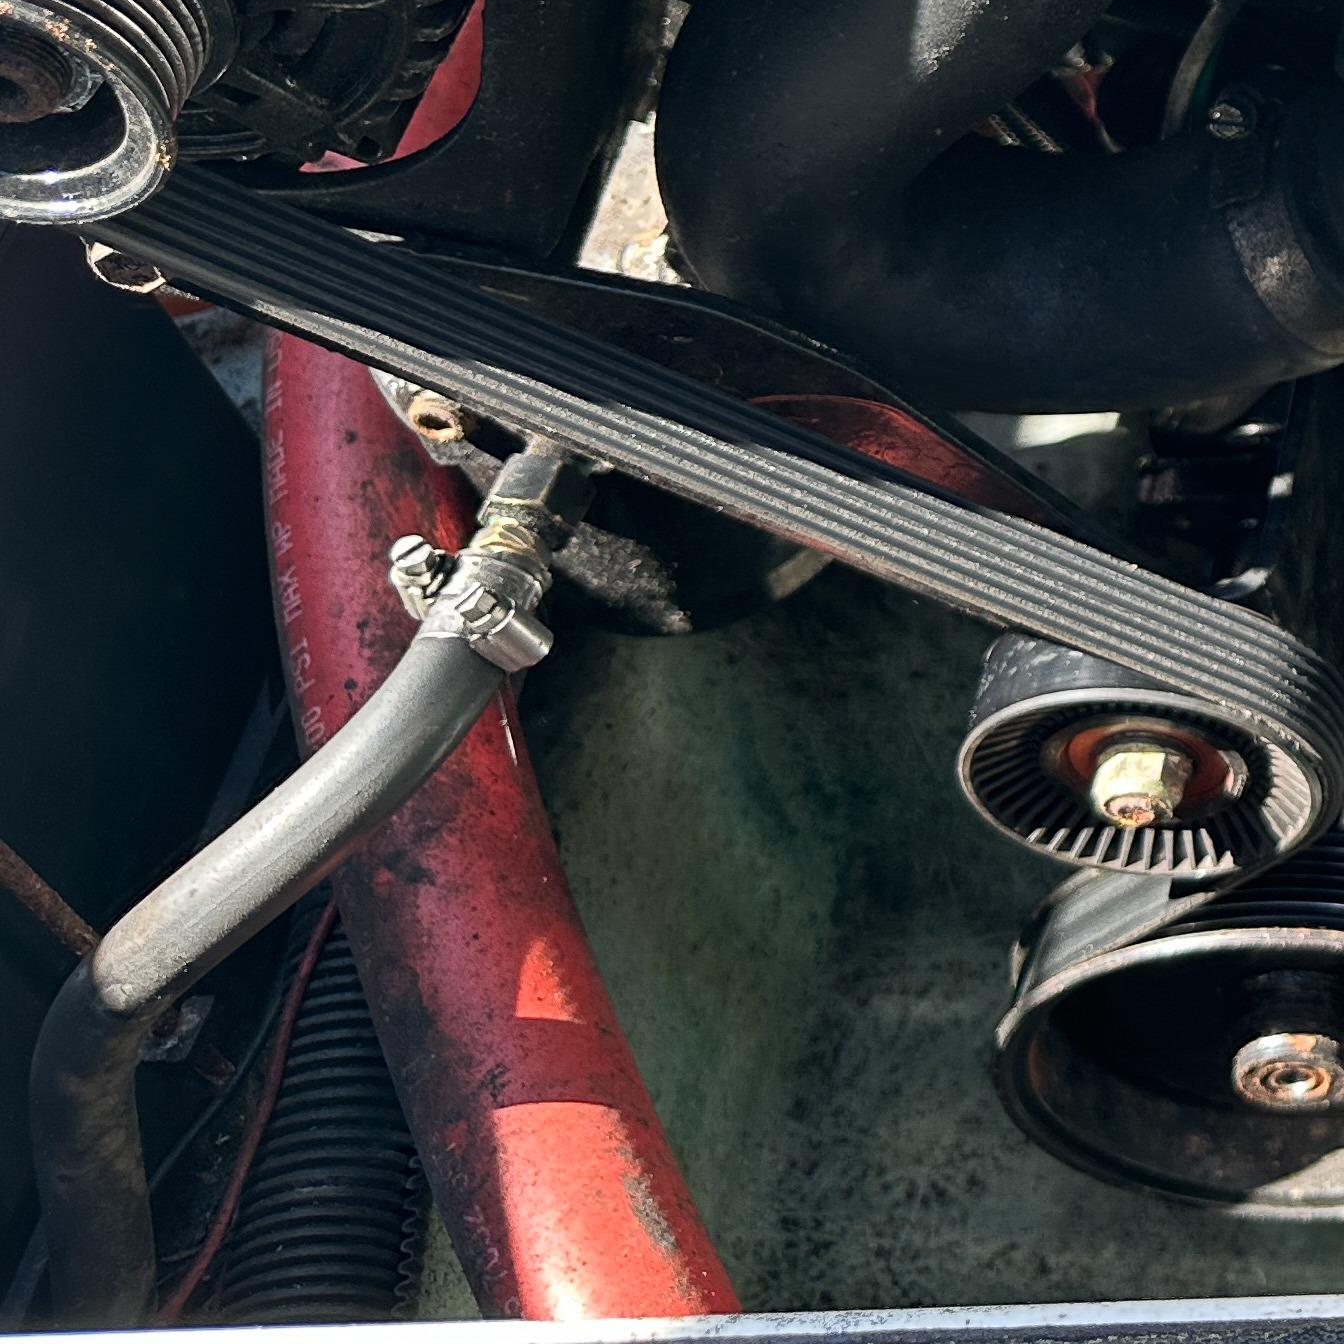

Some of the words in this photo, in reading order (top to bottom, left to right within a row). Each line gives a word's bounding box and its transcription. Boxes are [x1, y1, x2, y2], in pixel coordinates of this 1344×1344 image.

[264, 378, 284, 414] IN
[265, 429, 288, 506] MADE
[271, 520, 294, 557] WP
[278, 564, 303, 625] MAX
[289, 636, 315, 697] PSI
[300, 704, 328, 752] 00
